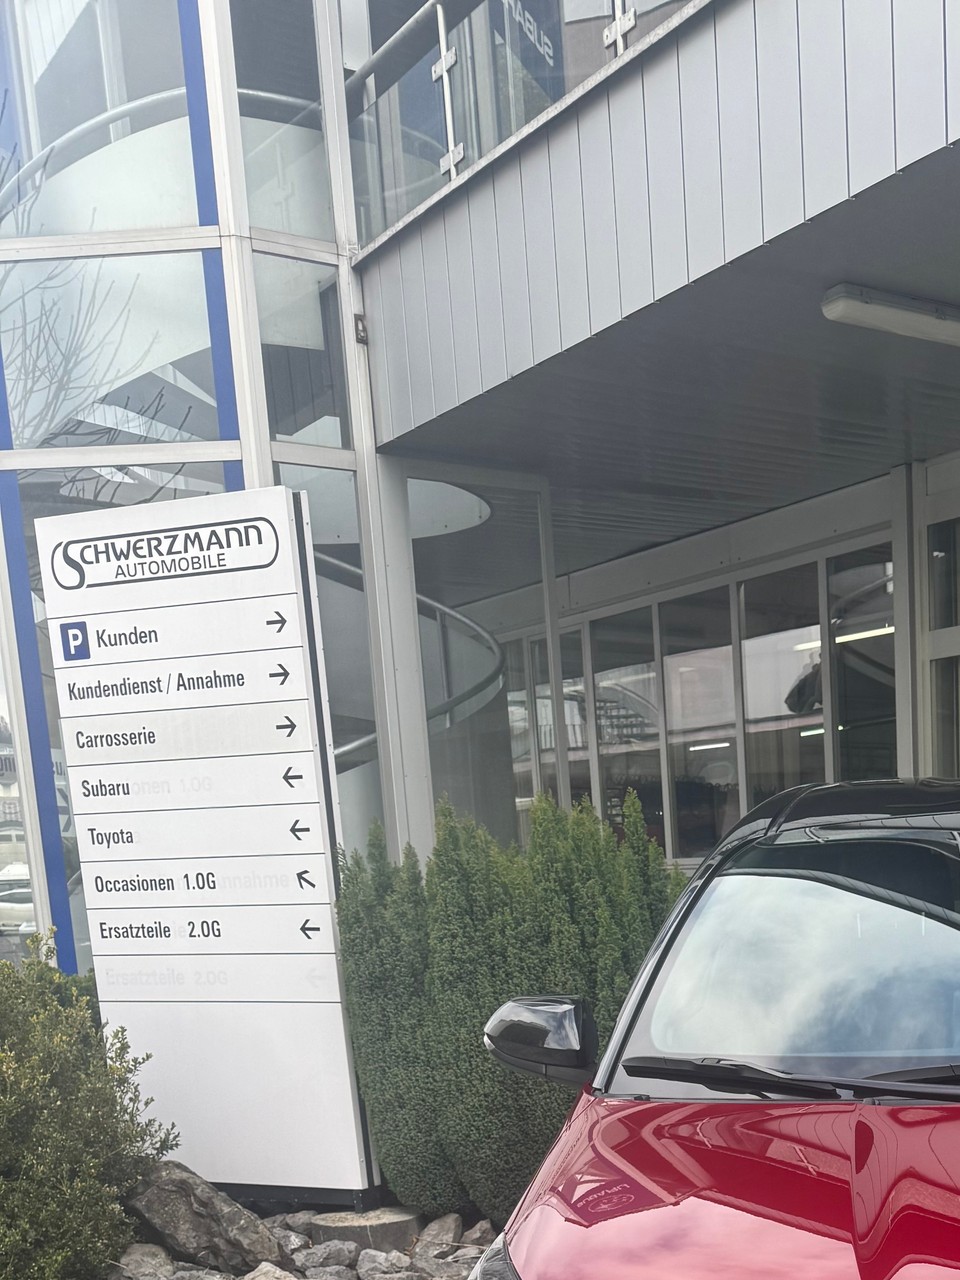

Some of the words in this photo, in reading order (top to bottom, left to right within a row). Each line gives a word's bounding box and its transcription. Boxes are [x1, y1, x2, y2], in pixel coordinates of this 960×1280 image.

[60, 522, 265, 590] SCHWERZMANN
[114, 553, 227, 580] AUTOMOBILE
[95, 627, 159, 649] Kunden
[67, 677, 163, 701] Kundendienst
[176, 670, 245, 692] Annahme
[75, 727, 156, 749] Carrosserie
[81, 780, 131, 798] Subaru
[88, 828, 134, 849] Toyota
[94, 875, 175, 893] Occasionen
[99, 922, 172, 940] Ersatzteile
